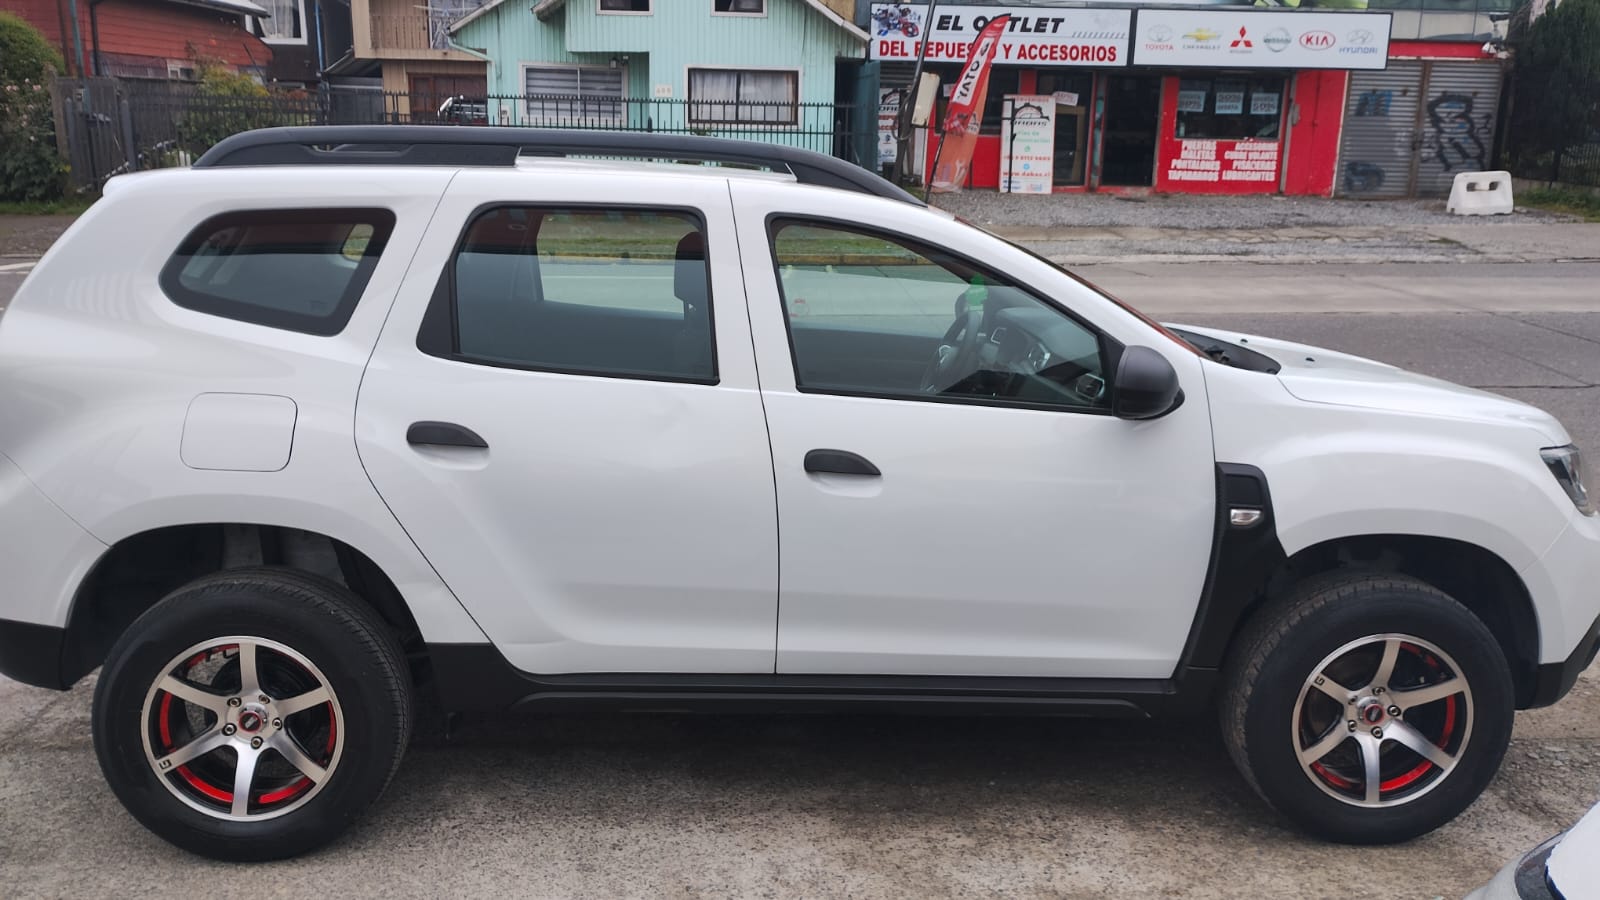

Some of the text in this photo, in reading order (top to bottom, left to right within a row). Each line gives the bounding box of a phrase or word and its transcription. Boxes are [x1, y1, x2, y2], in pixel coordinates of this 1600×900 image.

[936, 15, 1064, 33] EL OTLET
[1305, 35, 1329, 46] KIA
[880, 40, 908, 57] DEL
[1003, 43, 1012, 59] Y
[1017, 43, 1116, 61] ACCESORIOS
[1145, 43, 1174, 51] TOYOTA
[1339, 46, 1378, 54] HYUNDAI
